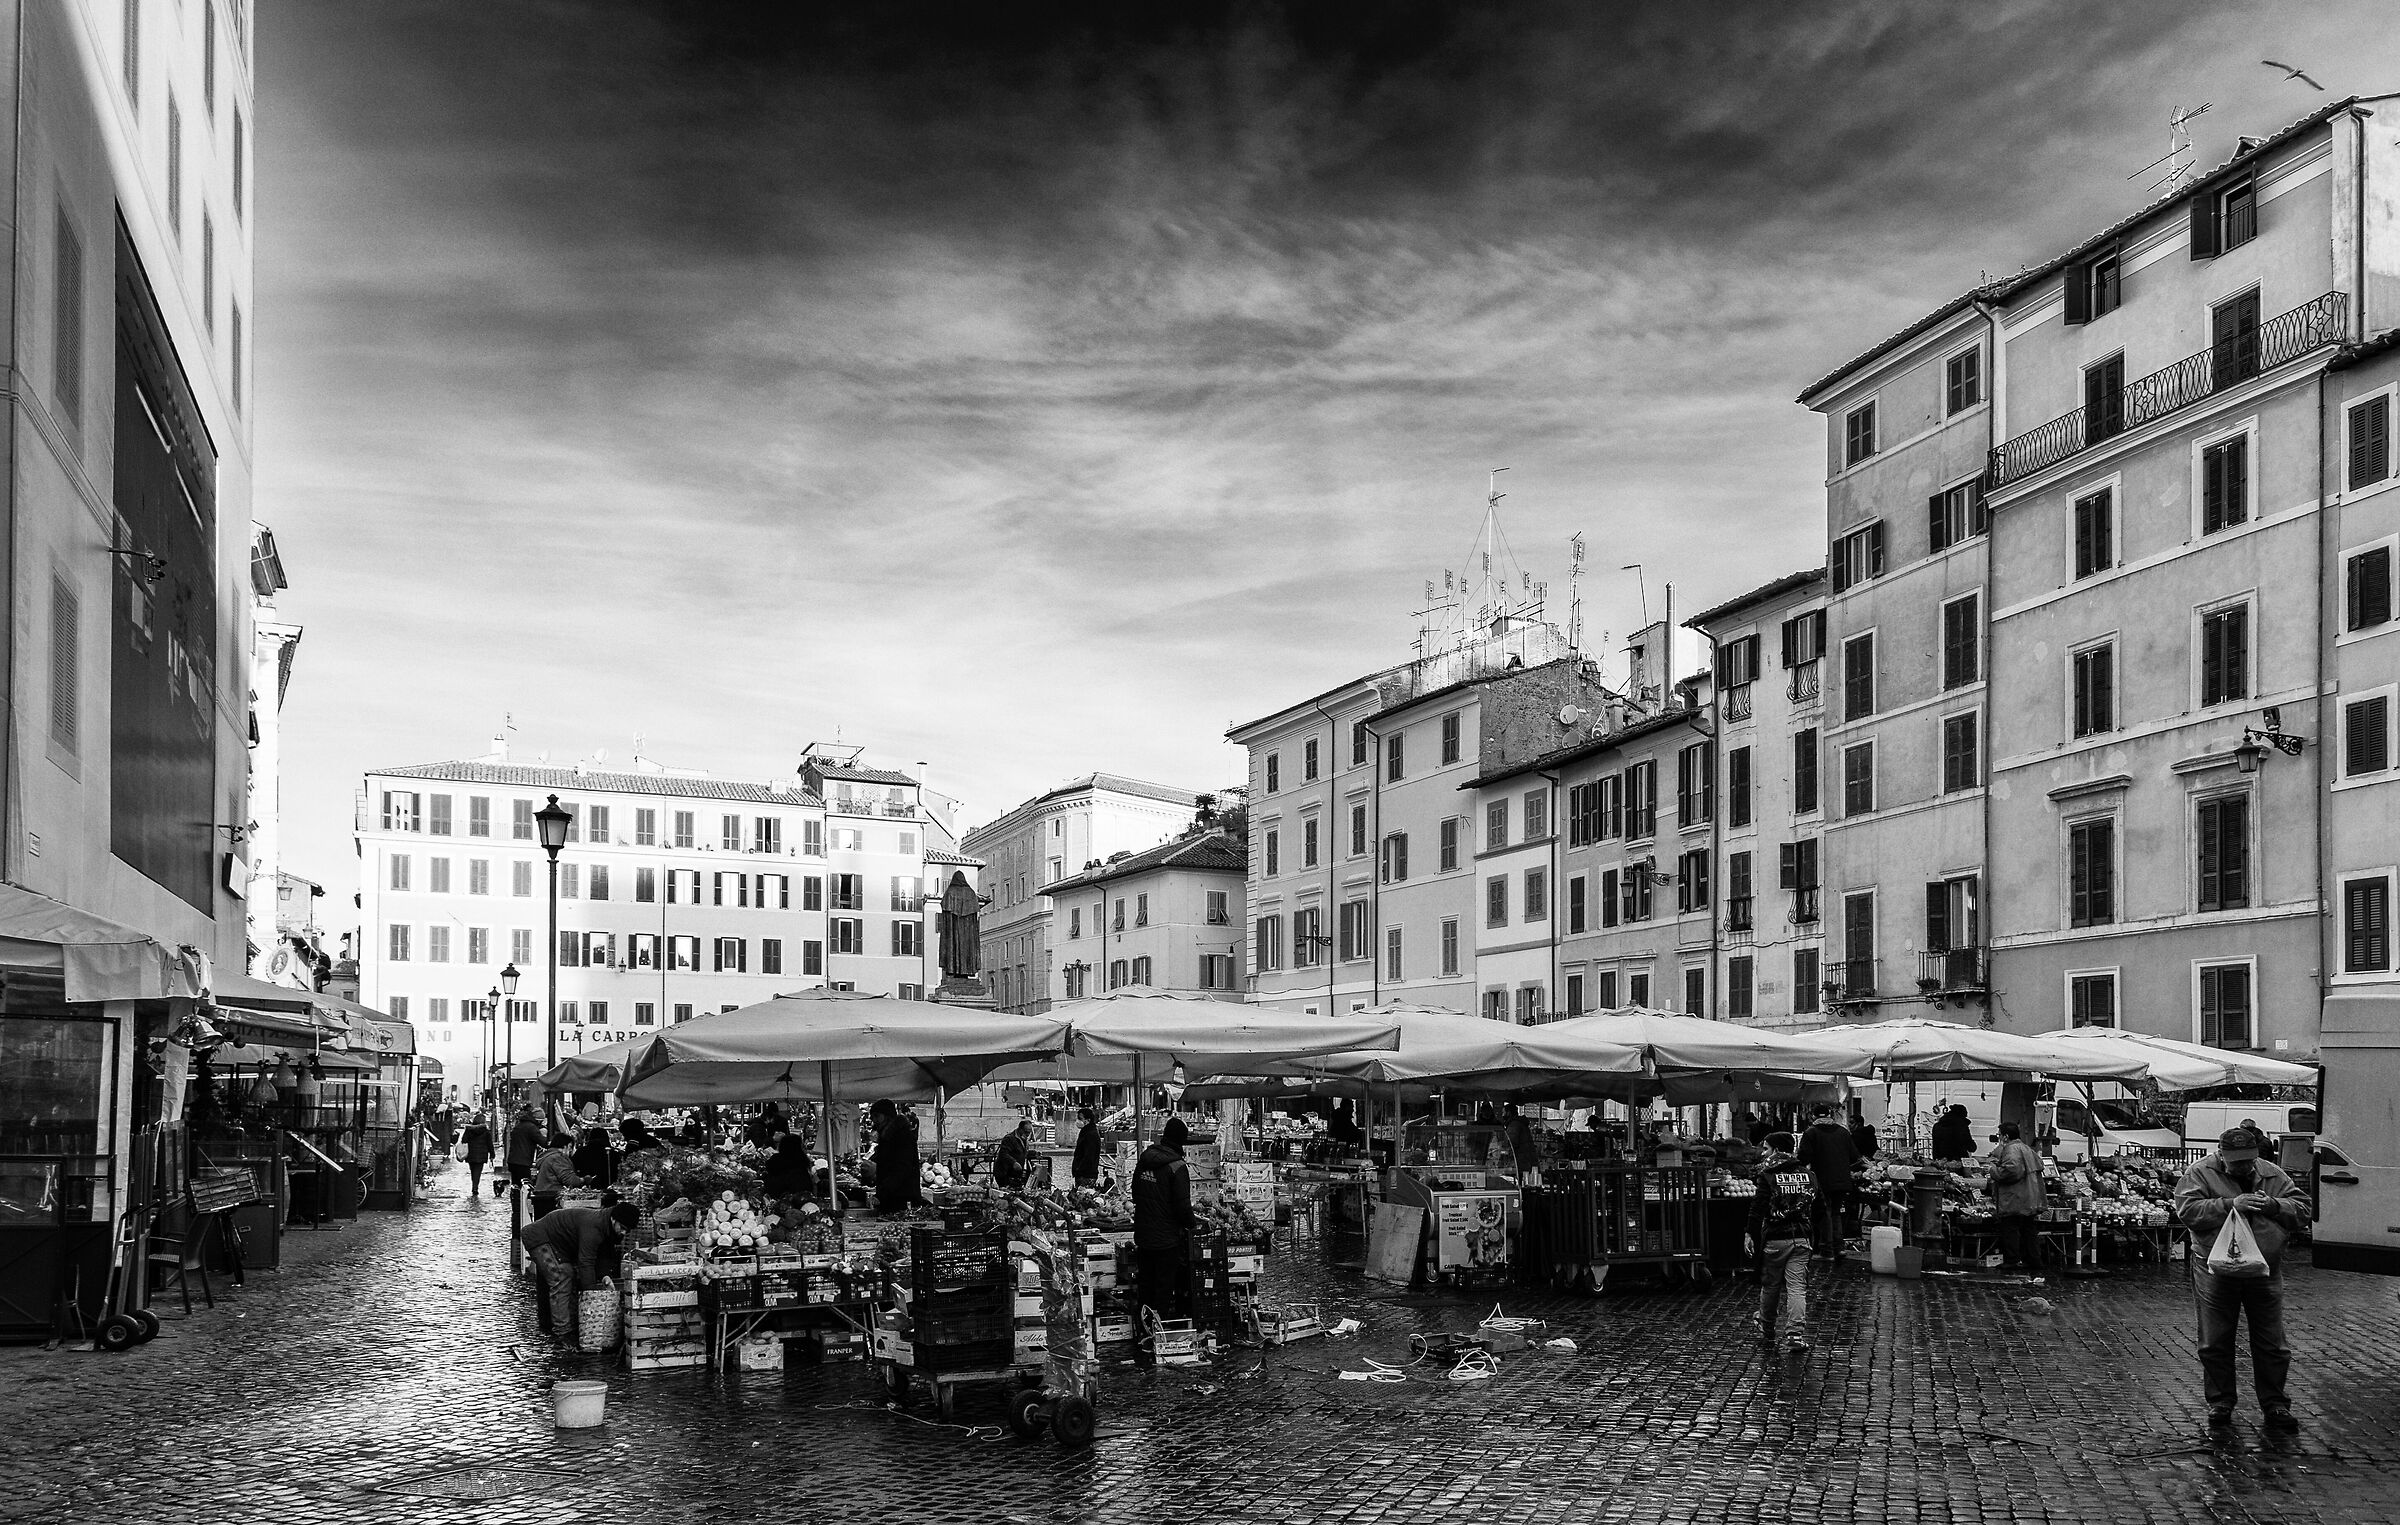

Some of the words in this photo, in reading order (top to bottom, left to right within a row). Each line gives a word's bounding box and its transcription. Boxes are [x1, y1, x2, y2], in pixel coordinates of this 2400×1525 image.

[559, 1030, 582, 1042] LA
[1777, 1174, 1807, 1182] SWORN
[1780, 1185, 1806, 1194] TRUCE
